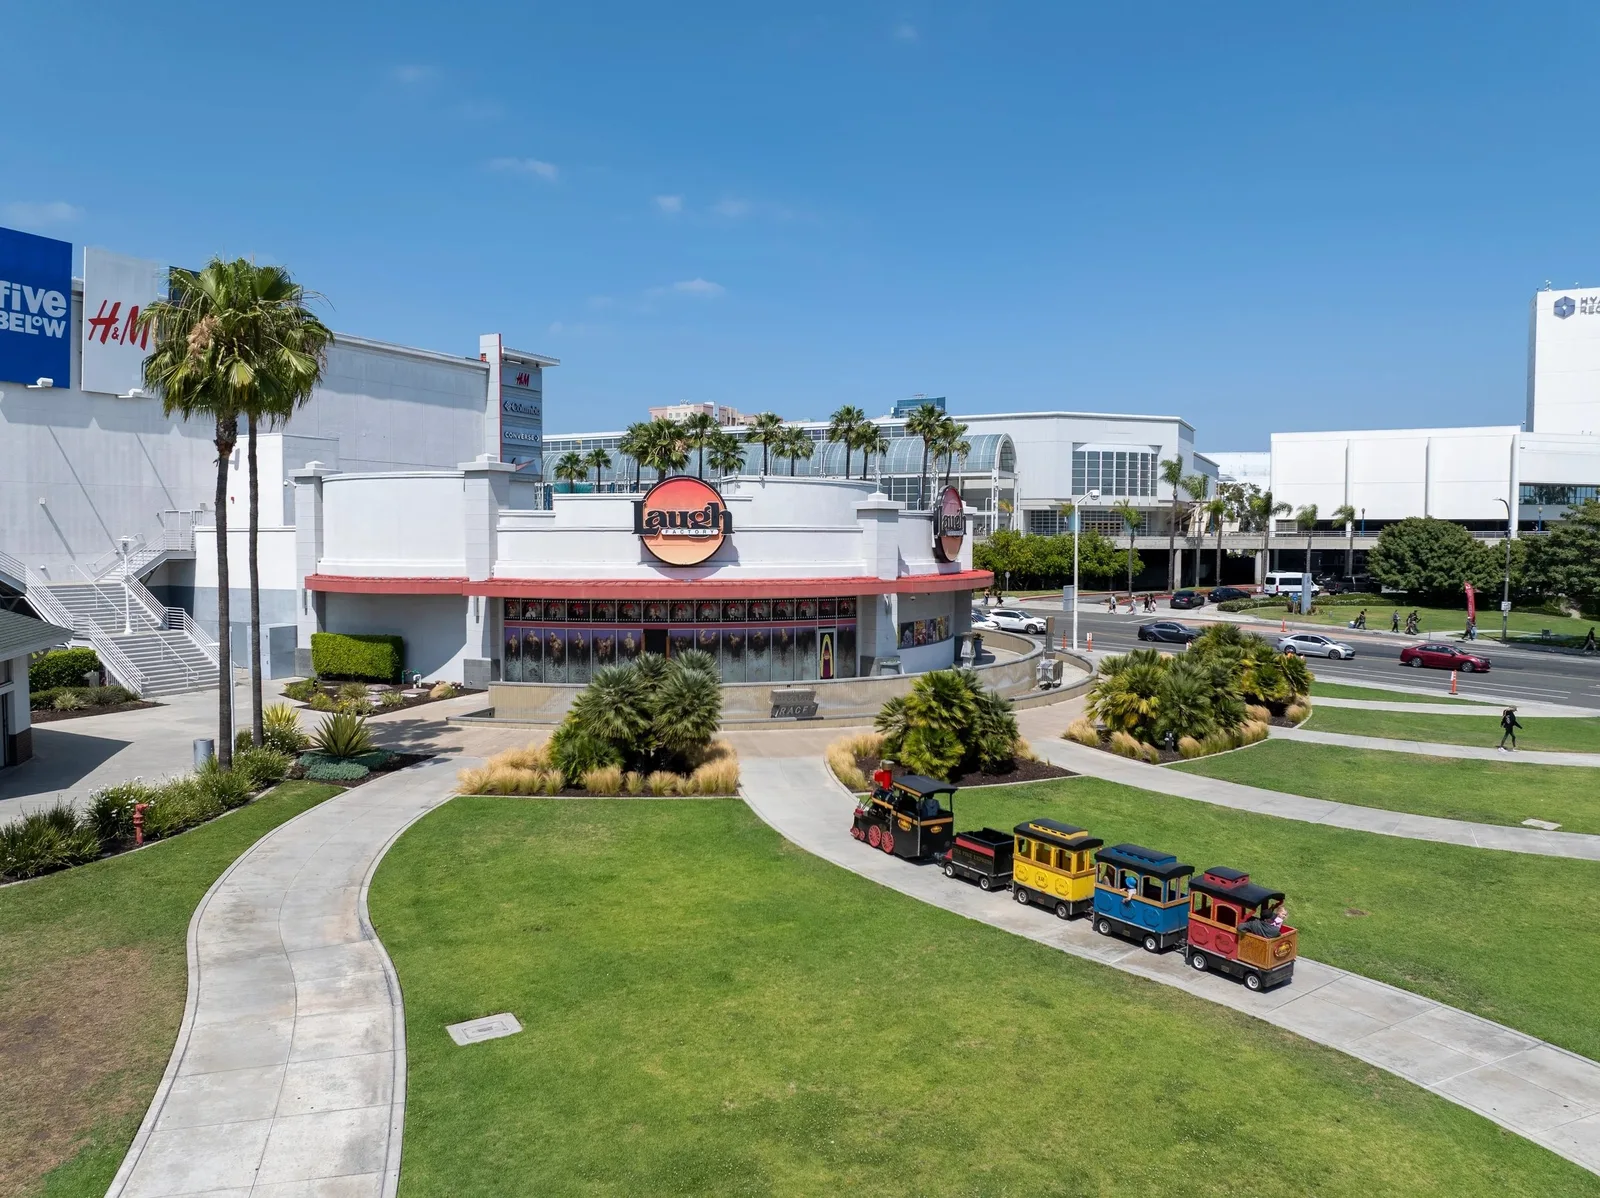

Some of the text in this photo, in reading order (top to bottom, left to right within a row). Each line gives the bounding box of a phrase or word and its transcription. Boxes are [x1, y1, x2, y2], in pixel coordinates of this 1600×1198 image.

[0, 280, 67, 318] five
[1580, 296, 1600, 306] HY
[88, 299, 151, 351] H&M
[516, 372, 530, 387] H&M
[505, 431, 535, 441] CONVERSE
[631, 499, 735, 538] Laugh
